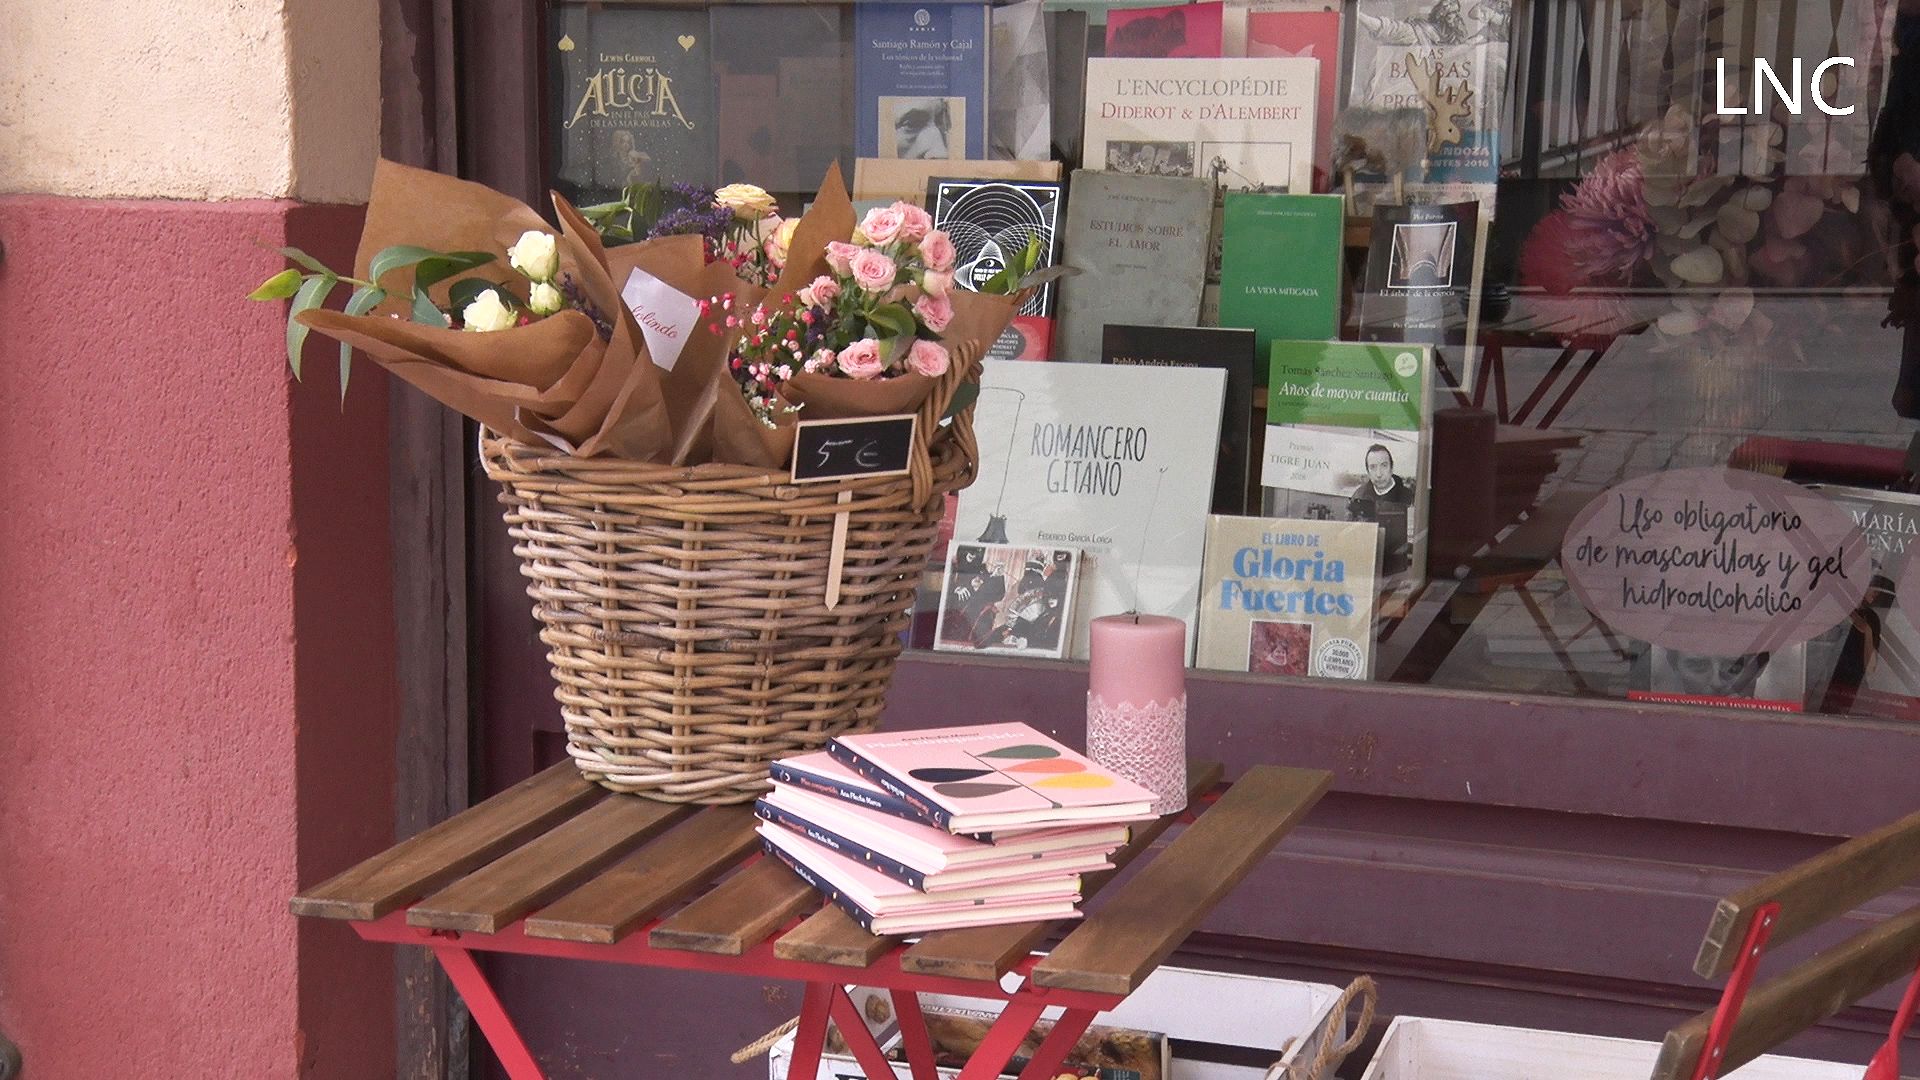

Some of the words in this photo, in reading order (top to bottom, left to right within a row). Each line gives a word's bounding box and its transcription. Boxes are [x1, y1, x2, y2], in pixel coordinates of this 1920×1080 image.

[872, 39, 908, 52] Santiago
[909, 39, 941, 49] Ramón
[942, 42, 949, 52] y
[950, 39, 973, 51] Cajal
[1117, 76, 1288, 97] L'ENCYCLOPÉDIE
[1181, 108, 1193, 120] &
[1090, 219, 1145, 234] ESTUDIOS
[1147, 224, 1185, 238] SOBRE
[1127, 239, 1161, 252] AMOR
[1245, 285, 1256, 294] LA
[1257, 285, 1277, 295] VIDA
[1278, 381, 1310, 397] Años
[1311, 382, 1325, 398] de
[1327, 387, 1364, 403] mayor
[1365, 389, 1410, 404] cuantía
[817, 439, 854, 469] 5
[1031, 422, 1147, 462] ROMANCERO
[1270, 453, 1300, 467] TIGRE
[1302, 457, 1331, 471] JUAN
[1047, 459, 1121, 497] GITANO
[1620, 493, 1663, 539] Uso
[1674, 499, 1801, 545] obligatorio
[1852, 510, 1919, 535] MARÍA
[1275, 533, 1304, 546] LIBRO
[1306, 535, 1320, 547] DE
[1233, 547, 1345, 583] Gloria
[1576, 536, 1608, 567] de
[1616, 538, 1770, 577] mascarillas
[1779, 551, 1800, 590] y
[1808, 546, 1848, 591] gel
[1220, 579, 1354, 617] Fuertes
[1623, 577, 1801, 616] hidroalcohólico
